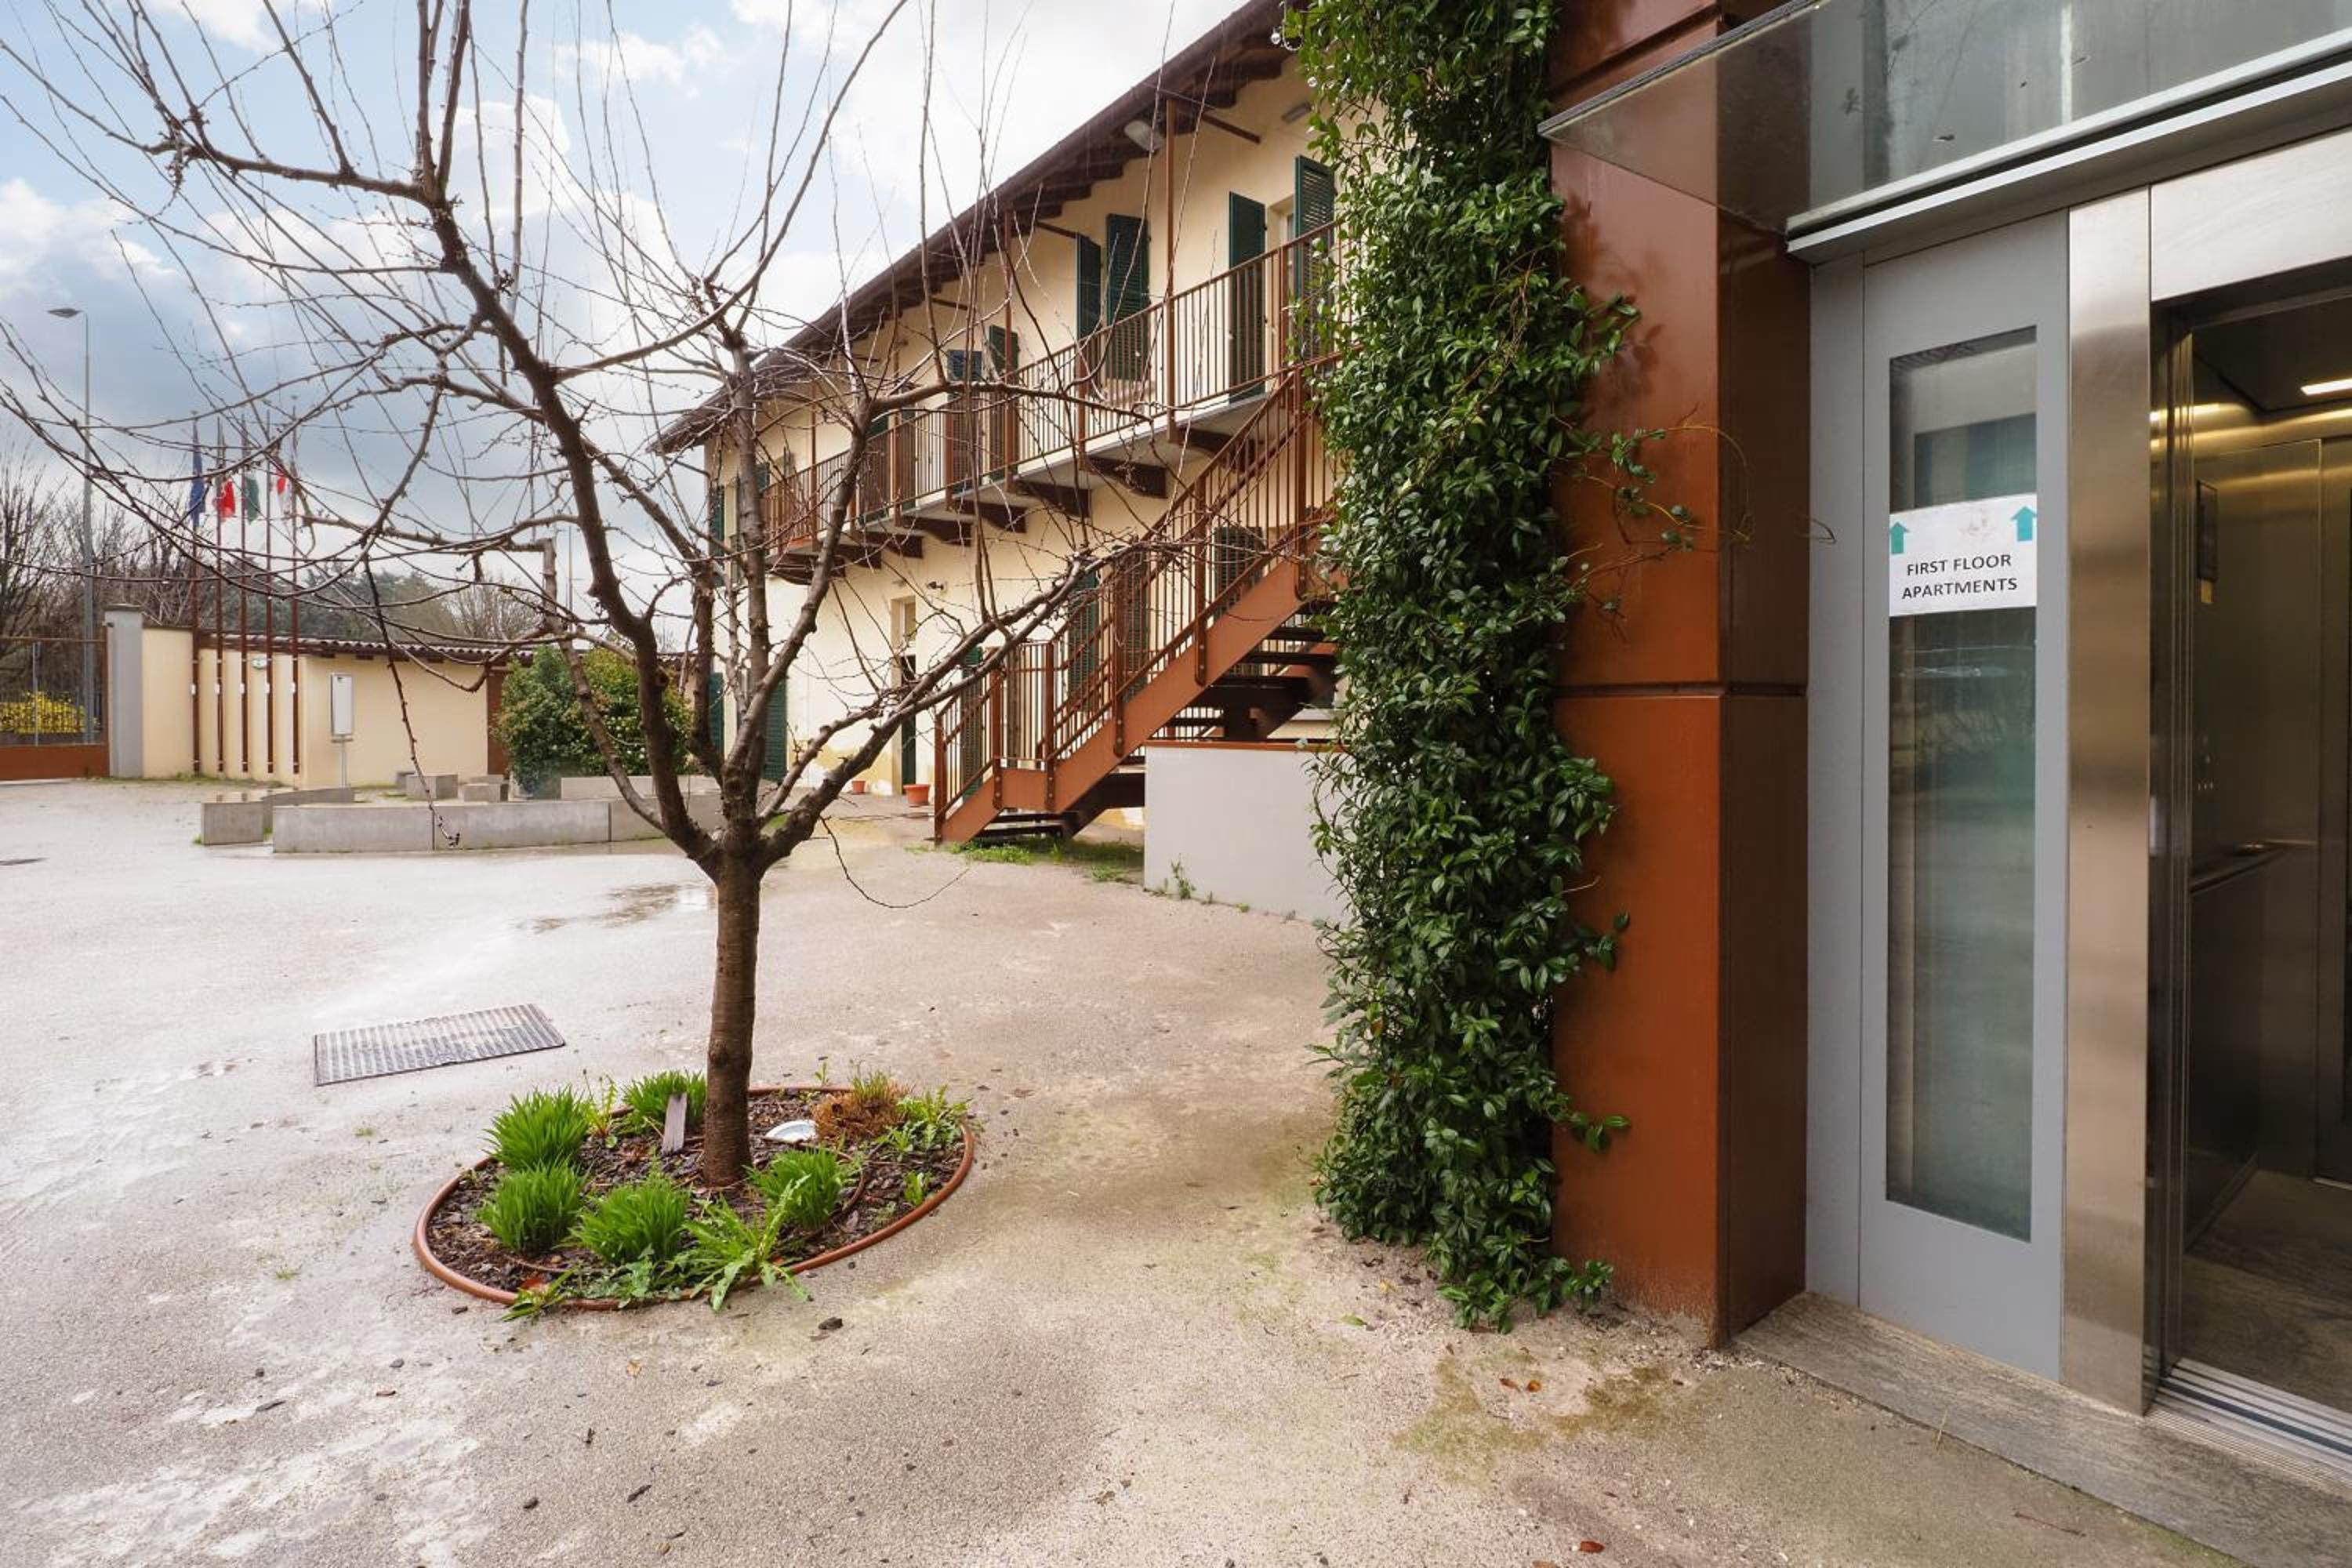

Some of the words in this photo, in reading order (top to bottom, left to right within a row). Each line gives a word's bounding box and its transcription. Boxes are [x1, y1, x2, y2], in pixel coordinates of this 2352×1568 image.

[1907, 560, 1947, 575] FIRST
[1953, 554, 2012, 571] FLOOR
[1902, 578, 2017, 599] APARTMENTS
